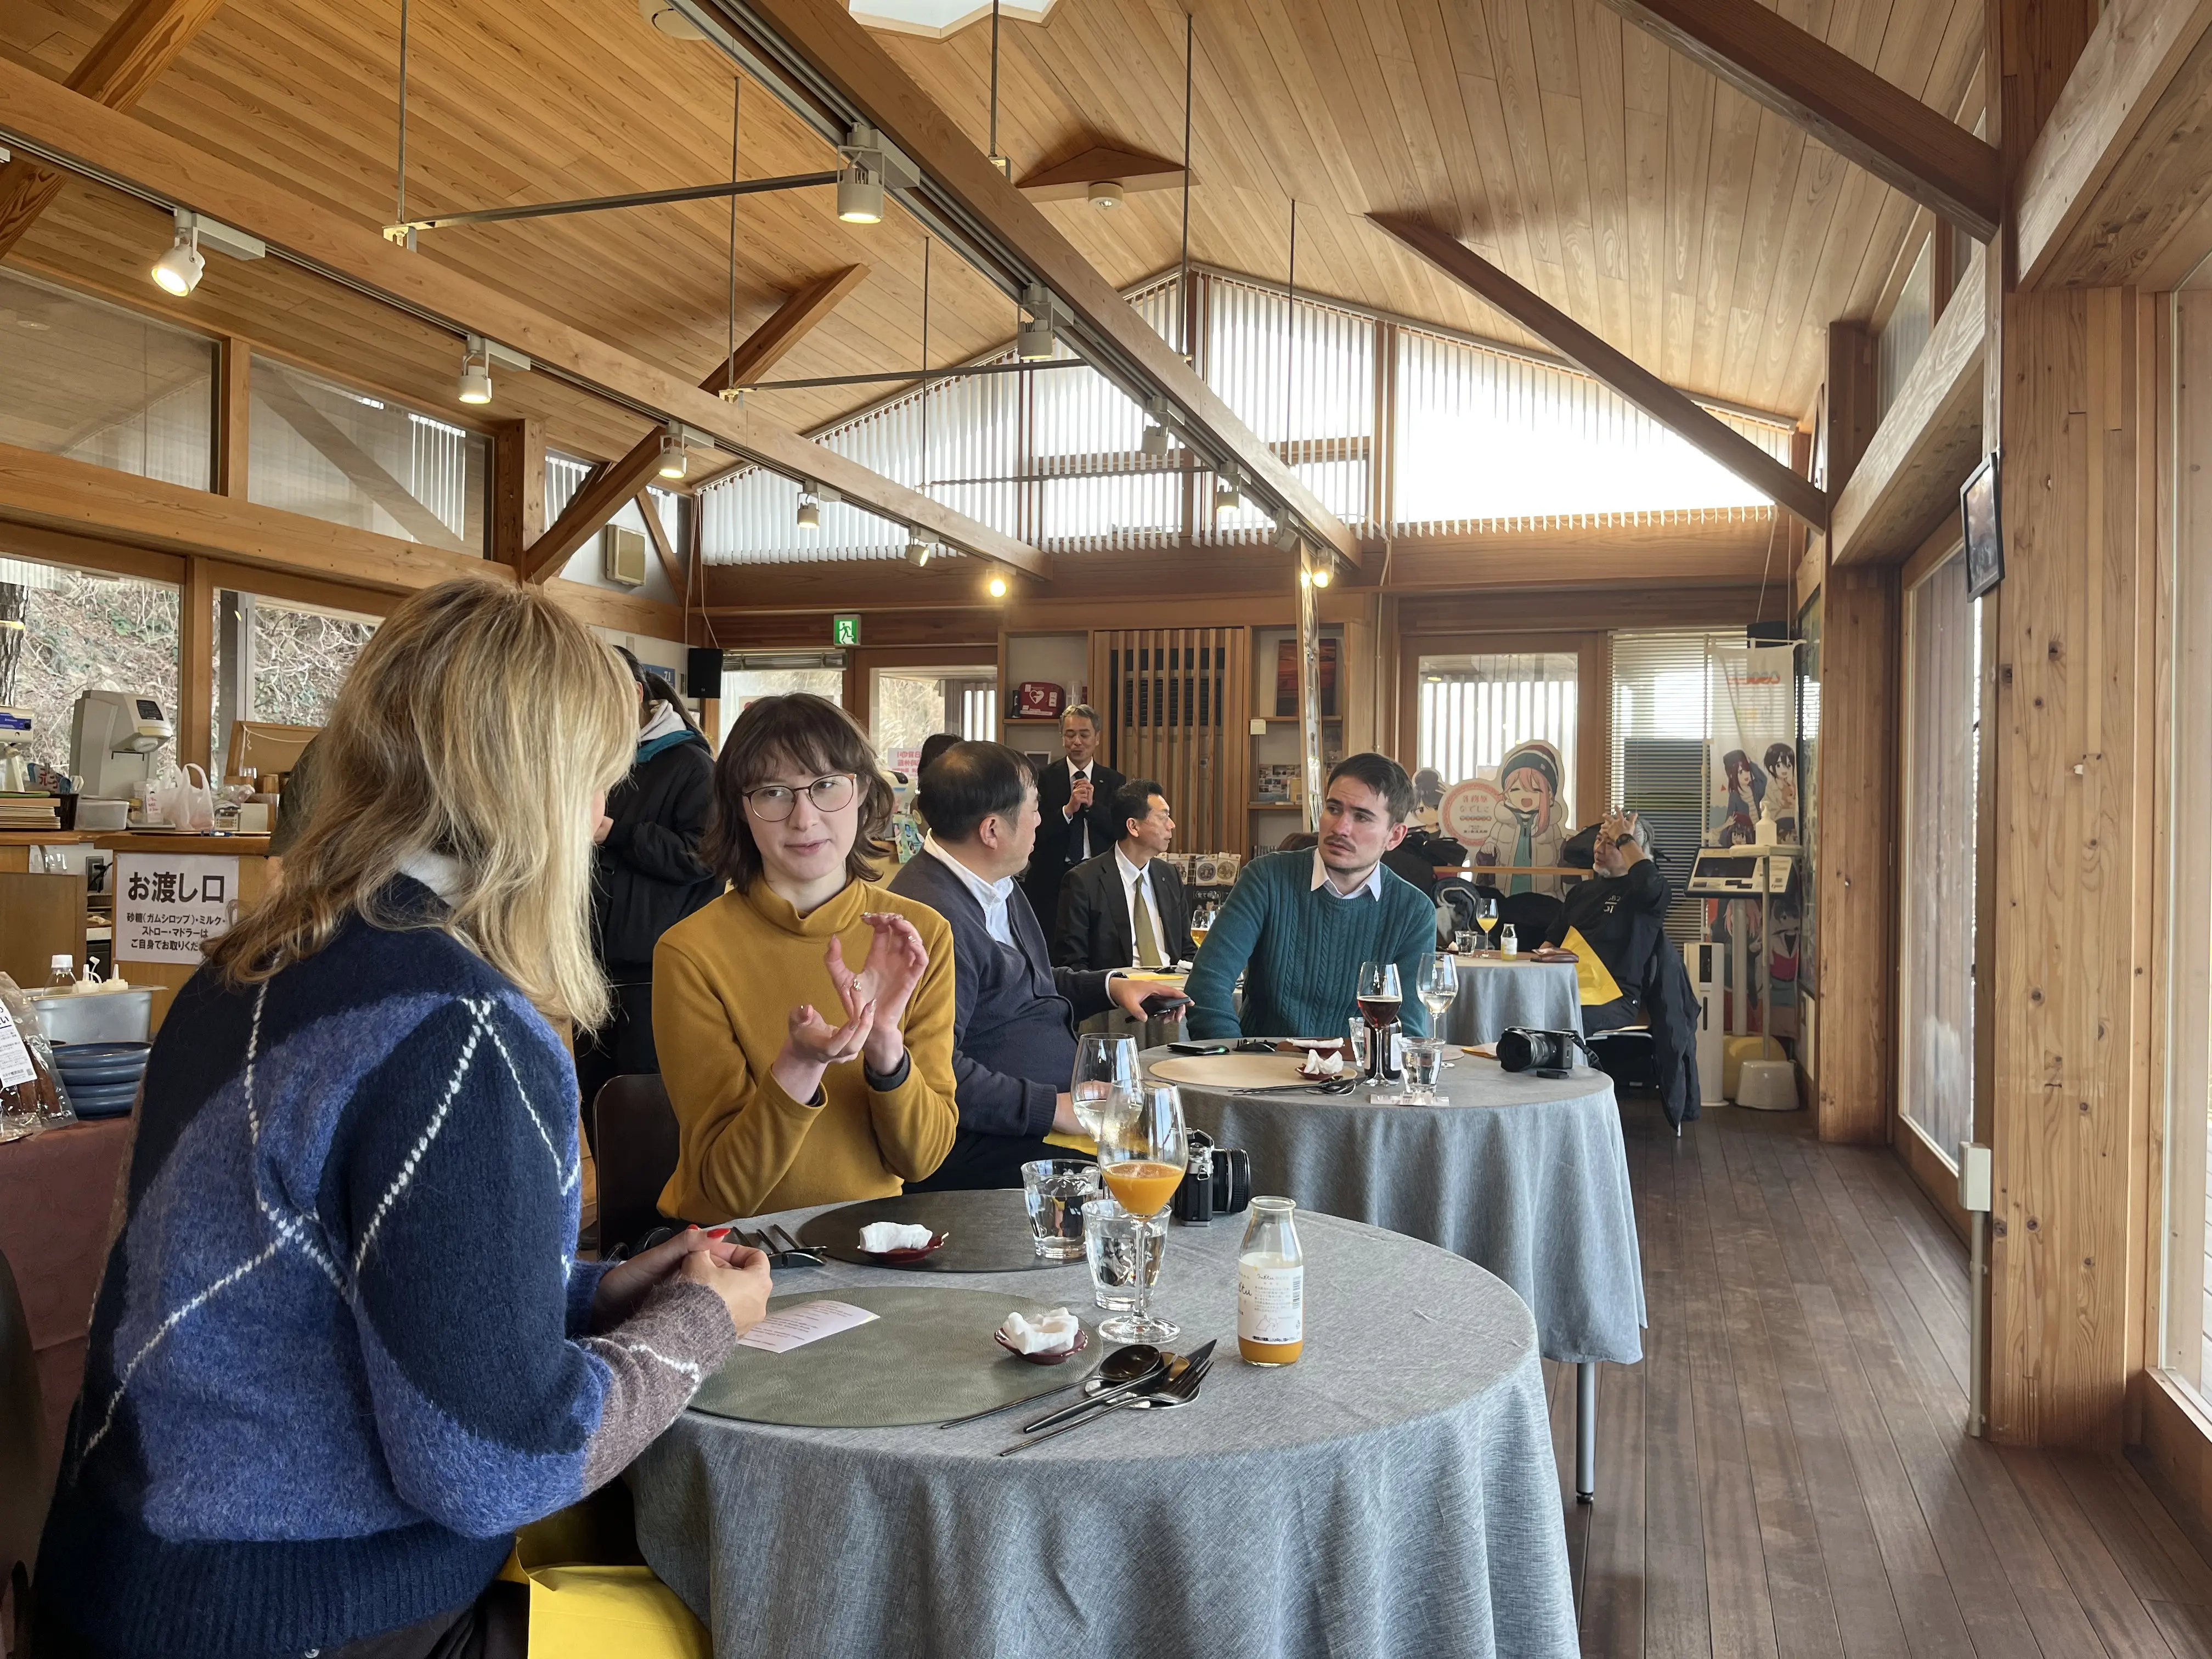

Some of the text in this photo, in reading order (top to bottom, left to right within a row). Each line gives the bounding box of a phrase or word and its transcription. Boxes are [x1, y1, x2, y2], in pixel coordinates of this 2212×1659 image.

[128, 871, 225, 904] お渡し口
[142, 926, 208, 938] ストロー・マドラーは
